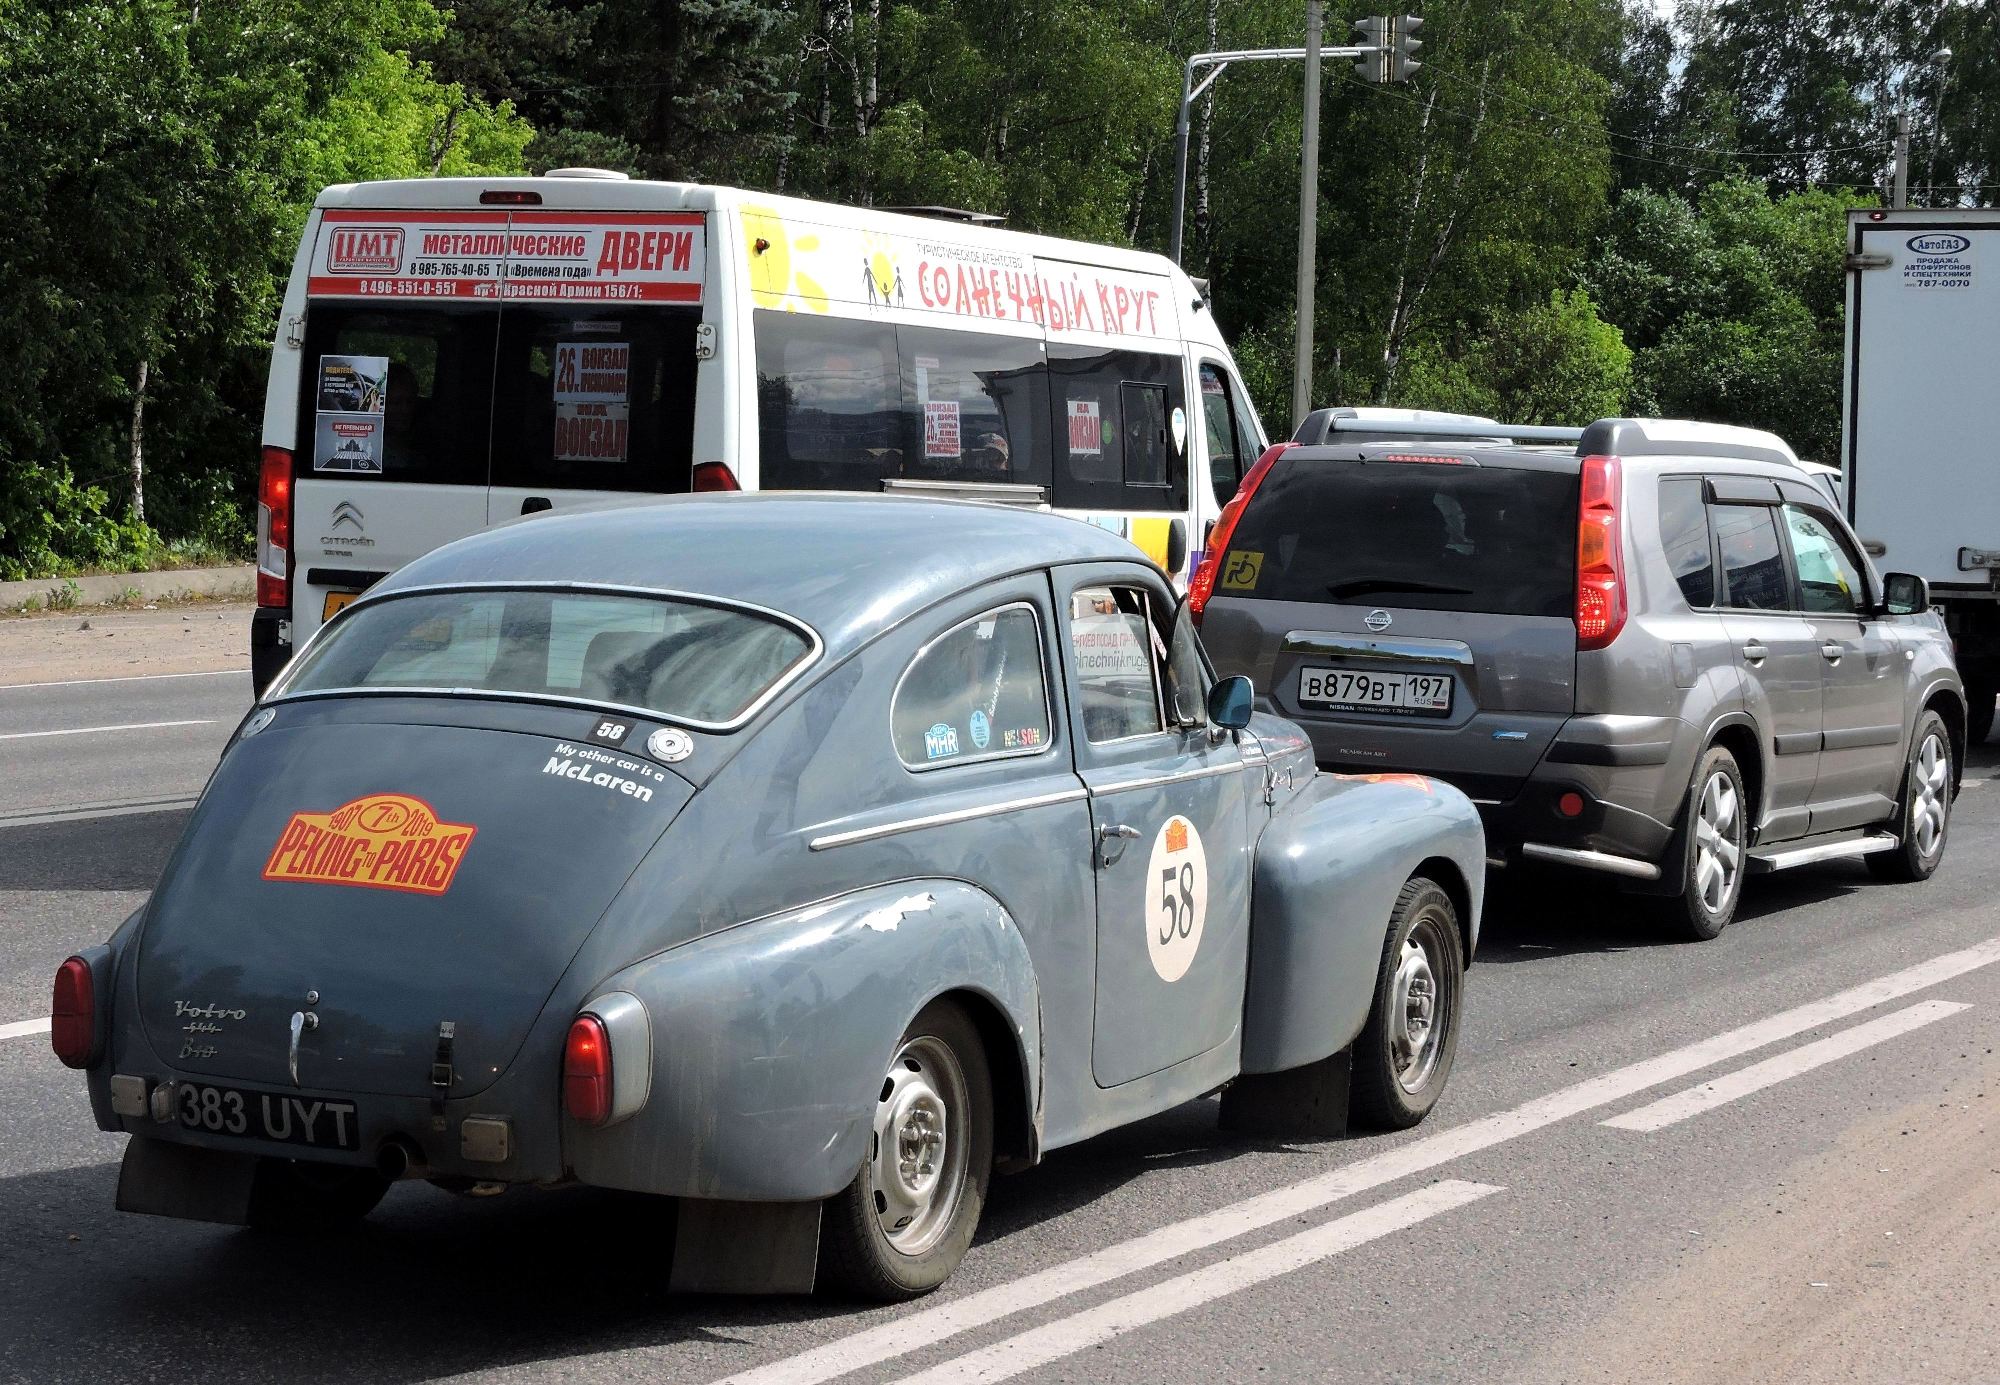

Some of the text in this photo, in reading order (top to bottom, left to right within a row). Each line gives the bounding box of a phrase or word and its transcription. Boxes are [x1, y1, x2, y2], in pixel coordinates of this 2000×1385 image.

[335, 232, 398, 267] ЦМТ
[423, 233, 586, 257] металлические
[596, 231, 694, 277] ДВЕРИ
[410, 262, 416, 276] 8
[418, 262, 490, 277] 985-765-40-65
[511, 264, 561, 279] «Времена
[563, 266, 592, 279] года»
[982, 253, 1023, 269] АГЕНТСТВО
[1916, 257, 1959, 265] ПРОДАЖА
[1911, 271, 1972, 279] СПЕЦТЕХНИКИ
[1918, 279, 1970, 288] 787-0070
[370, 280, 457, 295] 496-551-0-551
[503, 282, 557, 298] Красной
[559, 284, 601, 299] Армии
[918, 261, 1159, 335] СОЛНЕЧНЫЙ КРУГ
[581, 347, 627, 370] ВОКЗАЛ
[926, 403, 957, 413] ВОКЗАЛ
[555, 416, 627, 458] ВОКЗАЛ
[1070, 415, 1100, 450] ВОКЗАЛ
[1308, 673, 1444, 702] В879ВТ 197
[1329, 703, 1355, 712] NISSAN
[1414, 697, 1432, 705] RUS
[596, 722, 626, 740] 58
[1004, 728, 1041, 747] NELSON
[926, 731, 957, 757] MHR
[555, 743, 665, 783] My other car is a
[542, 756, 654, 803] McLaren
[328, 804, 434, 837] 1907 7th 2019
[269, 817, 468, 888] PEKING TO PARIS
[1159, 861, 1195, 946] 58
[174, 1000, 246, 1020] Volvo
[180, 1083, 354, 1147] 383 UYT
